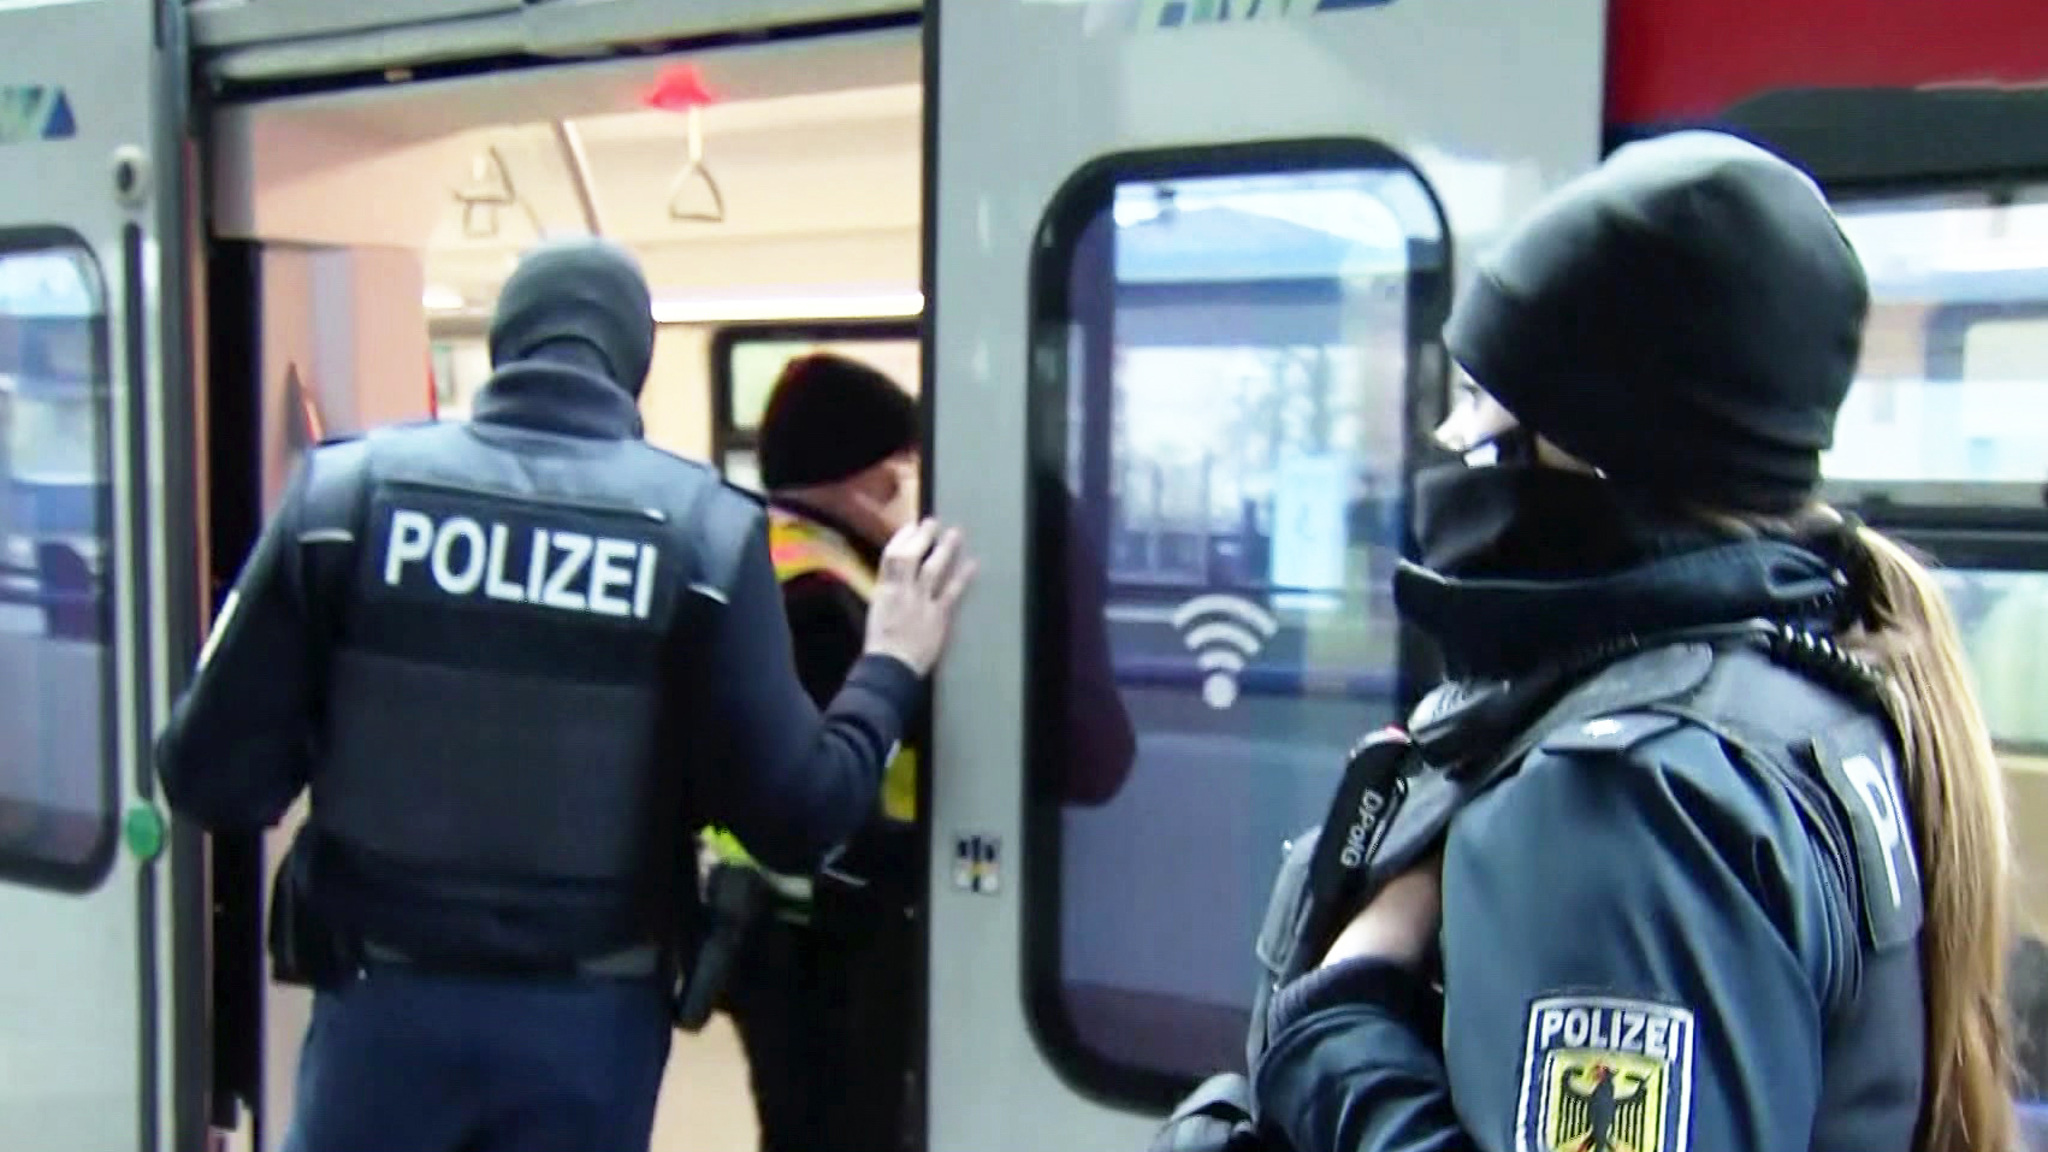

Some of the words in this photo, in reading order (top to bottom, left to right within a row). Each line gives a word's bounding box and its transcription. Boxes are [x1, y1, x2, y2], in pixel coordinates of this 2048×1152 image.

[384, 509, 658, 619] POLIZEI
[1841, 746, 1919, 910] P
[1540, 1008, 1682, 1062] POLIZEI
